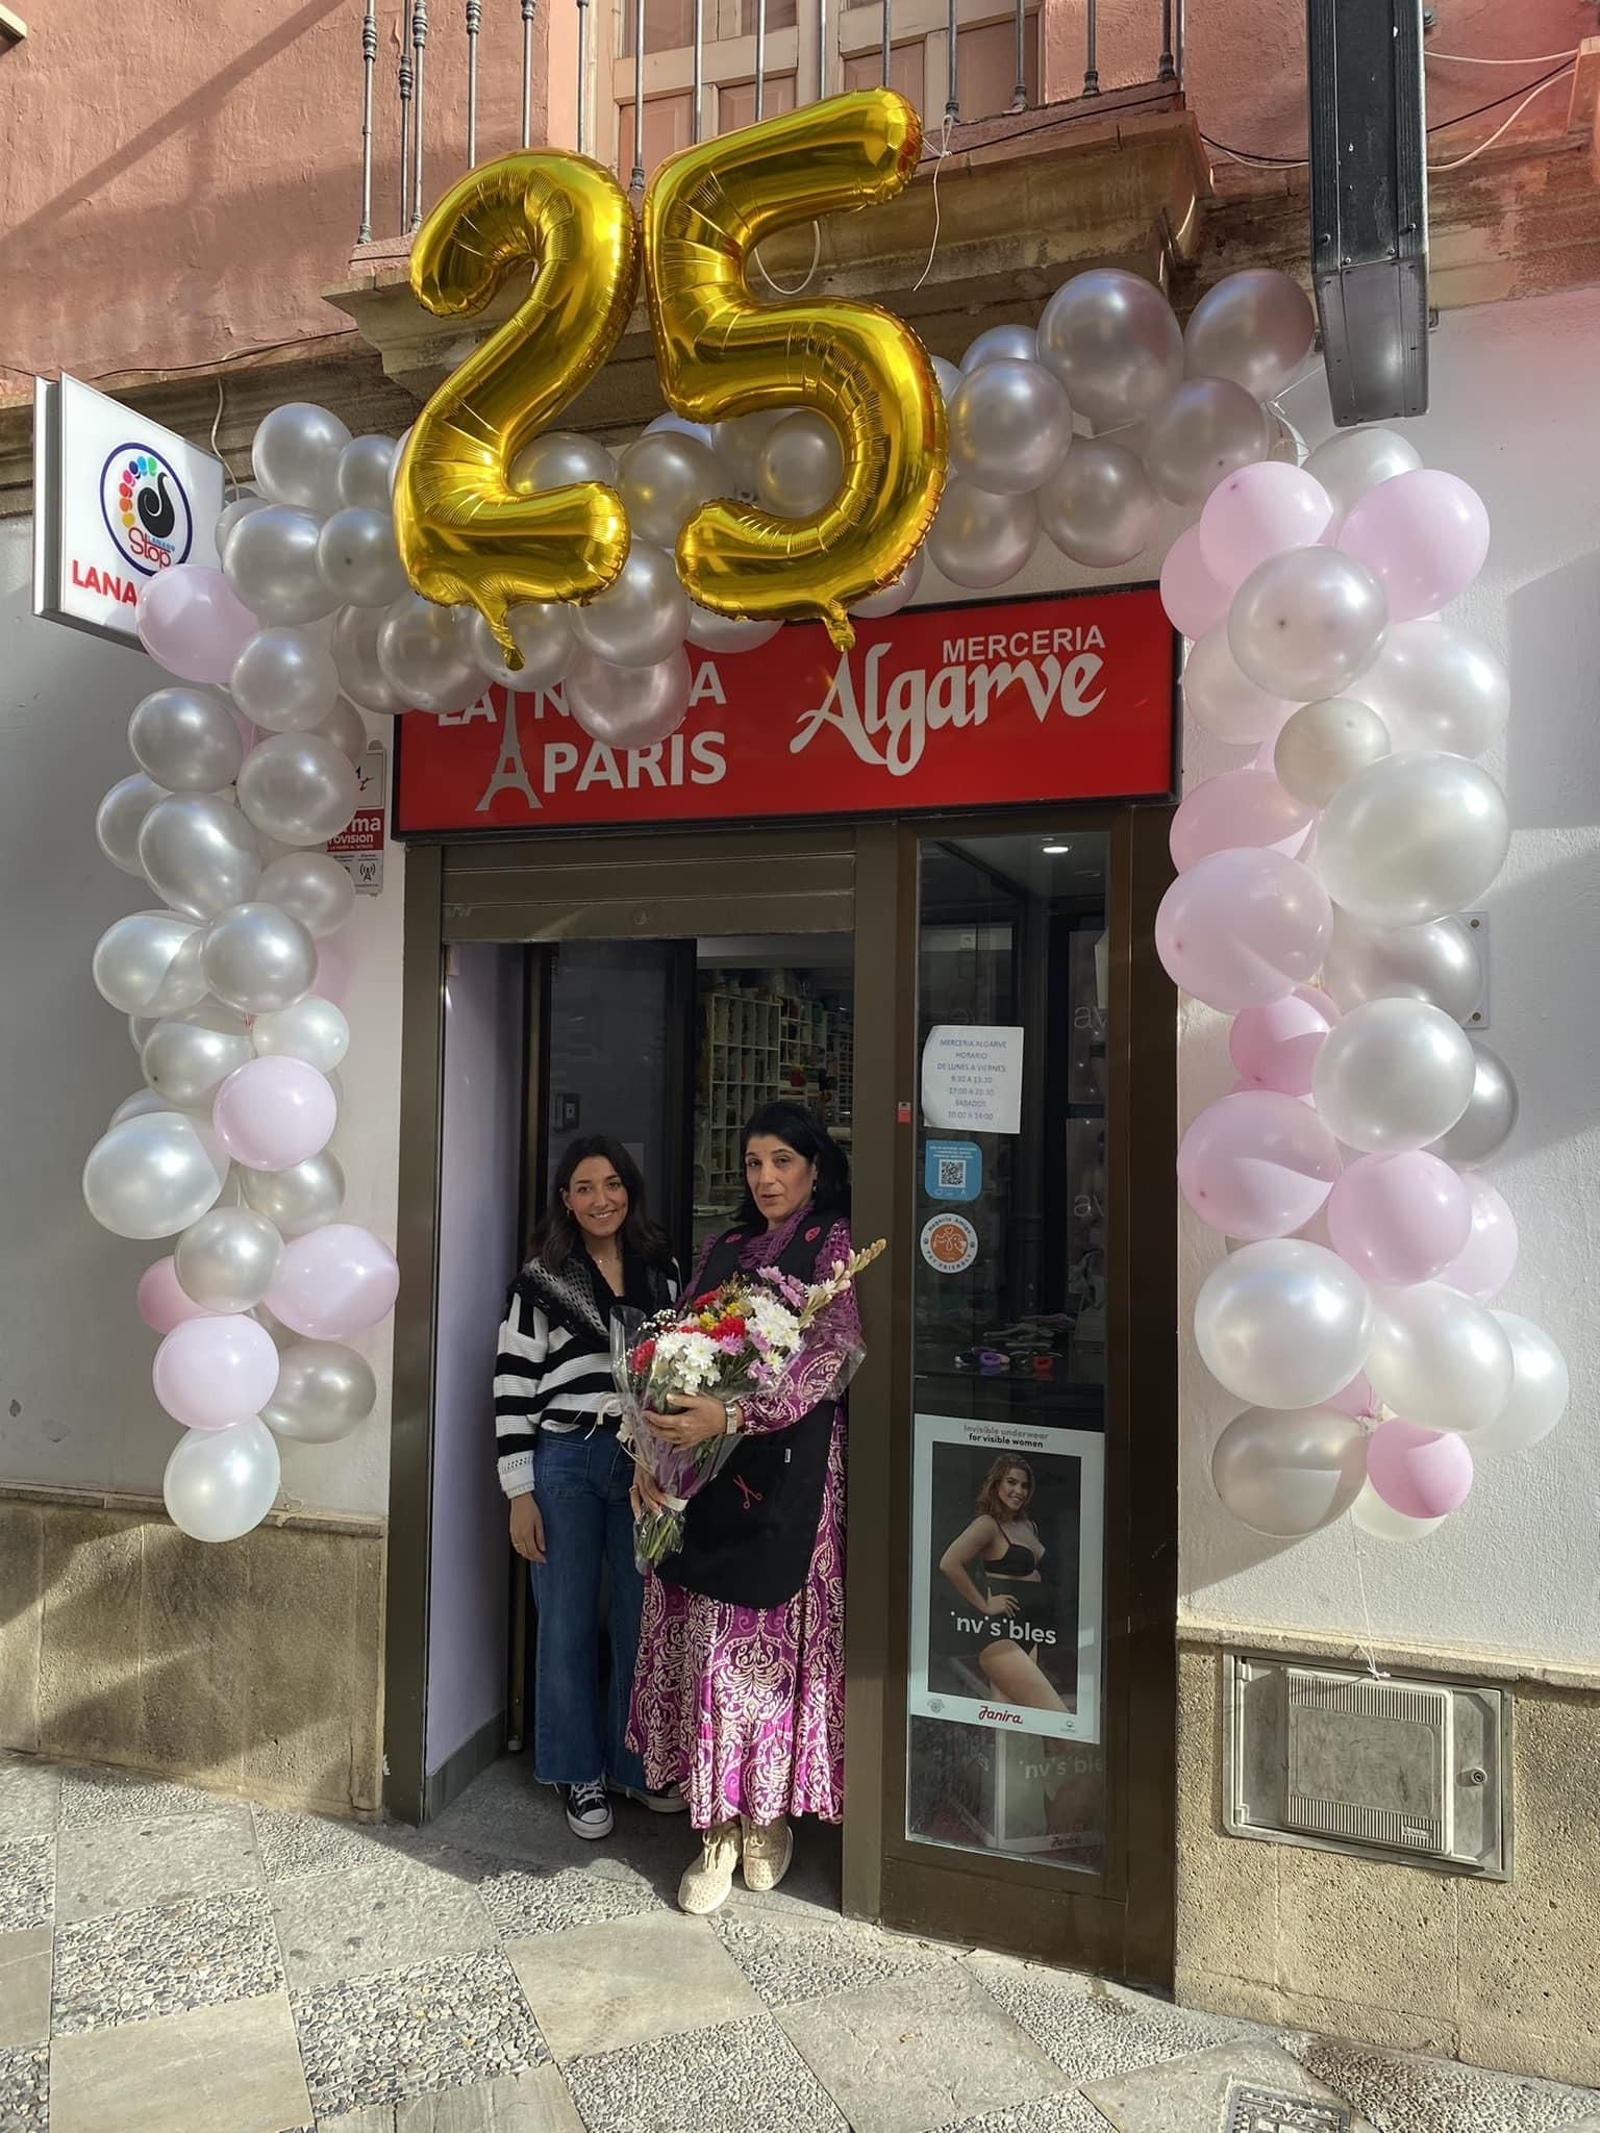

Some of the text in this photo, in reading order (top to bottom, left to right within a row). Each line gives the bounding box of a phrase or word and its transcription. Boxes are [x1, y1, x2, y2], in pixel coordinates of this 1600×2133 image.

[393, 87, 950, 622] 25
[128, 527, 171, 569] Stop
[942, 625, 1106, 664] MERCERIA
[789, 642, 1107, 776] Algarve
[969, 1432, 1043, 1448] for visible women
[1000, 1428, 1049, 1440] underwear
